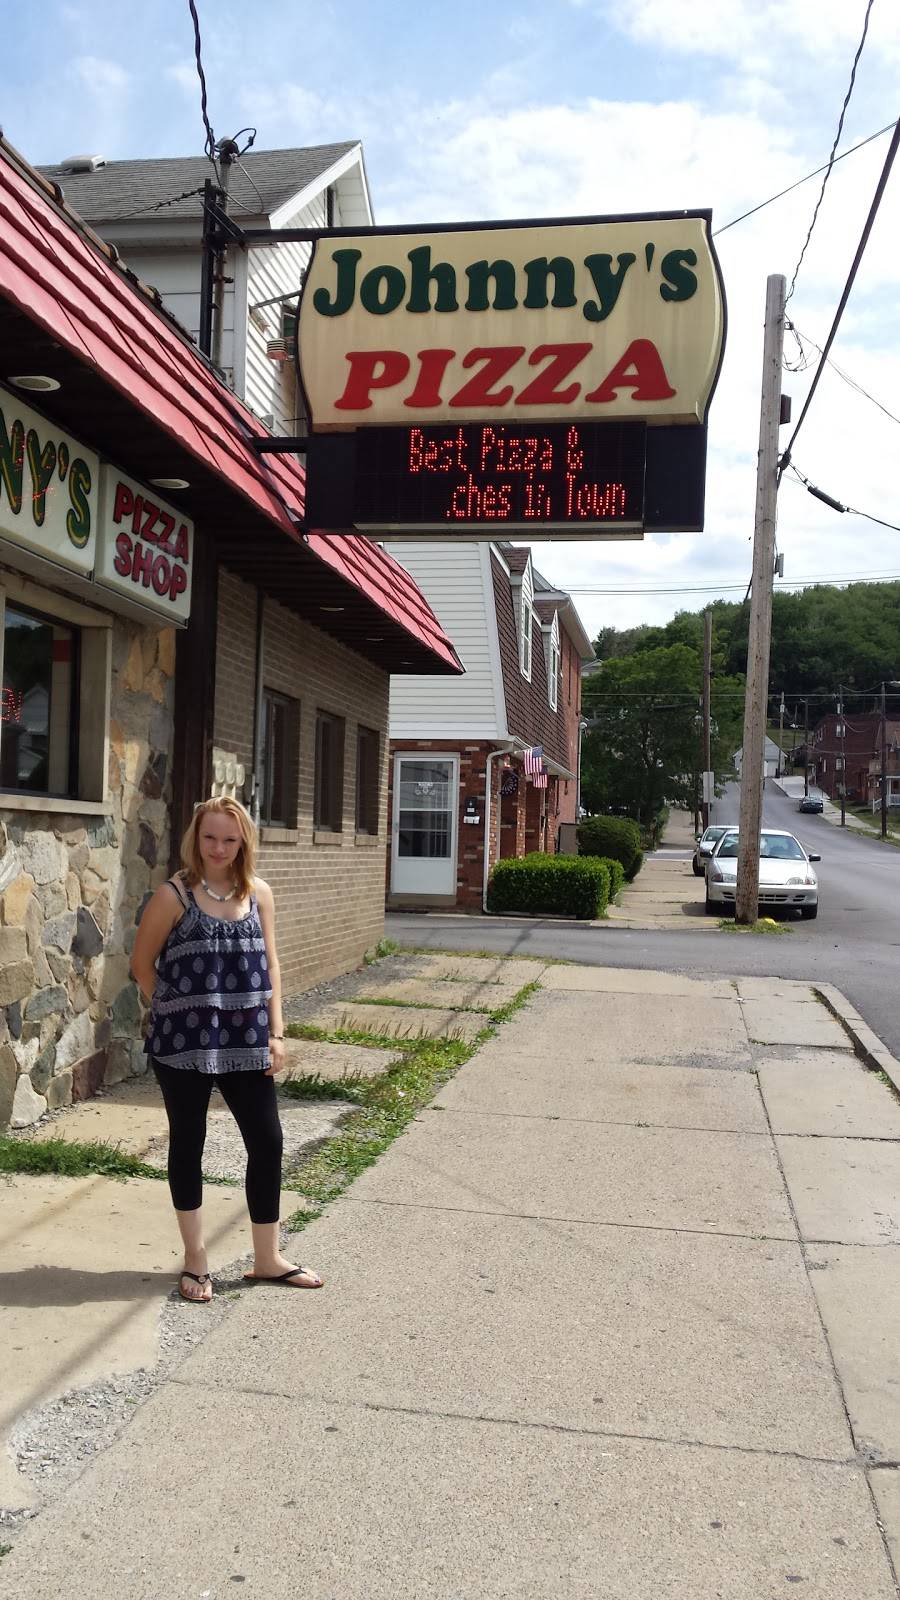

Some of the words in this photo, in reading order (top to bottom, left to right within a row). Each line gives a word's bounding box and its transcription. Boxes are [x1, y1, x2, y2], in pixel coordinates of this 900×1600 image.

[313, 242, 698, 322] Johnny's
[334, 338, 676, 410] PIZZA
[409, 427, 468, 472] Best
[481, 426, 553, 472] Pizza
[112, 481, 189, 565] PIZZA
[446, 473, 512, 517] ches
[565, 471, 626, 516] Town
[113, 532, 188, 602] SHOP
